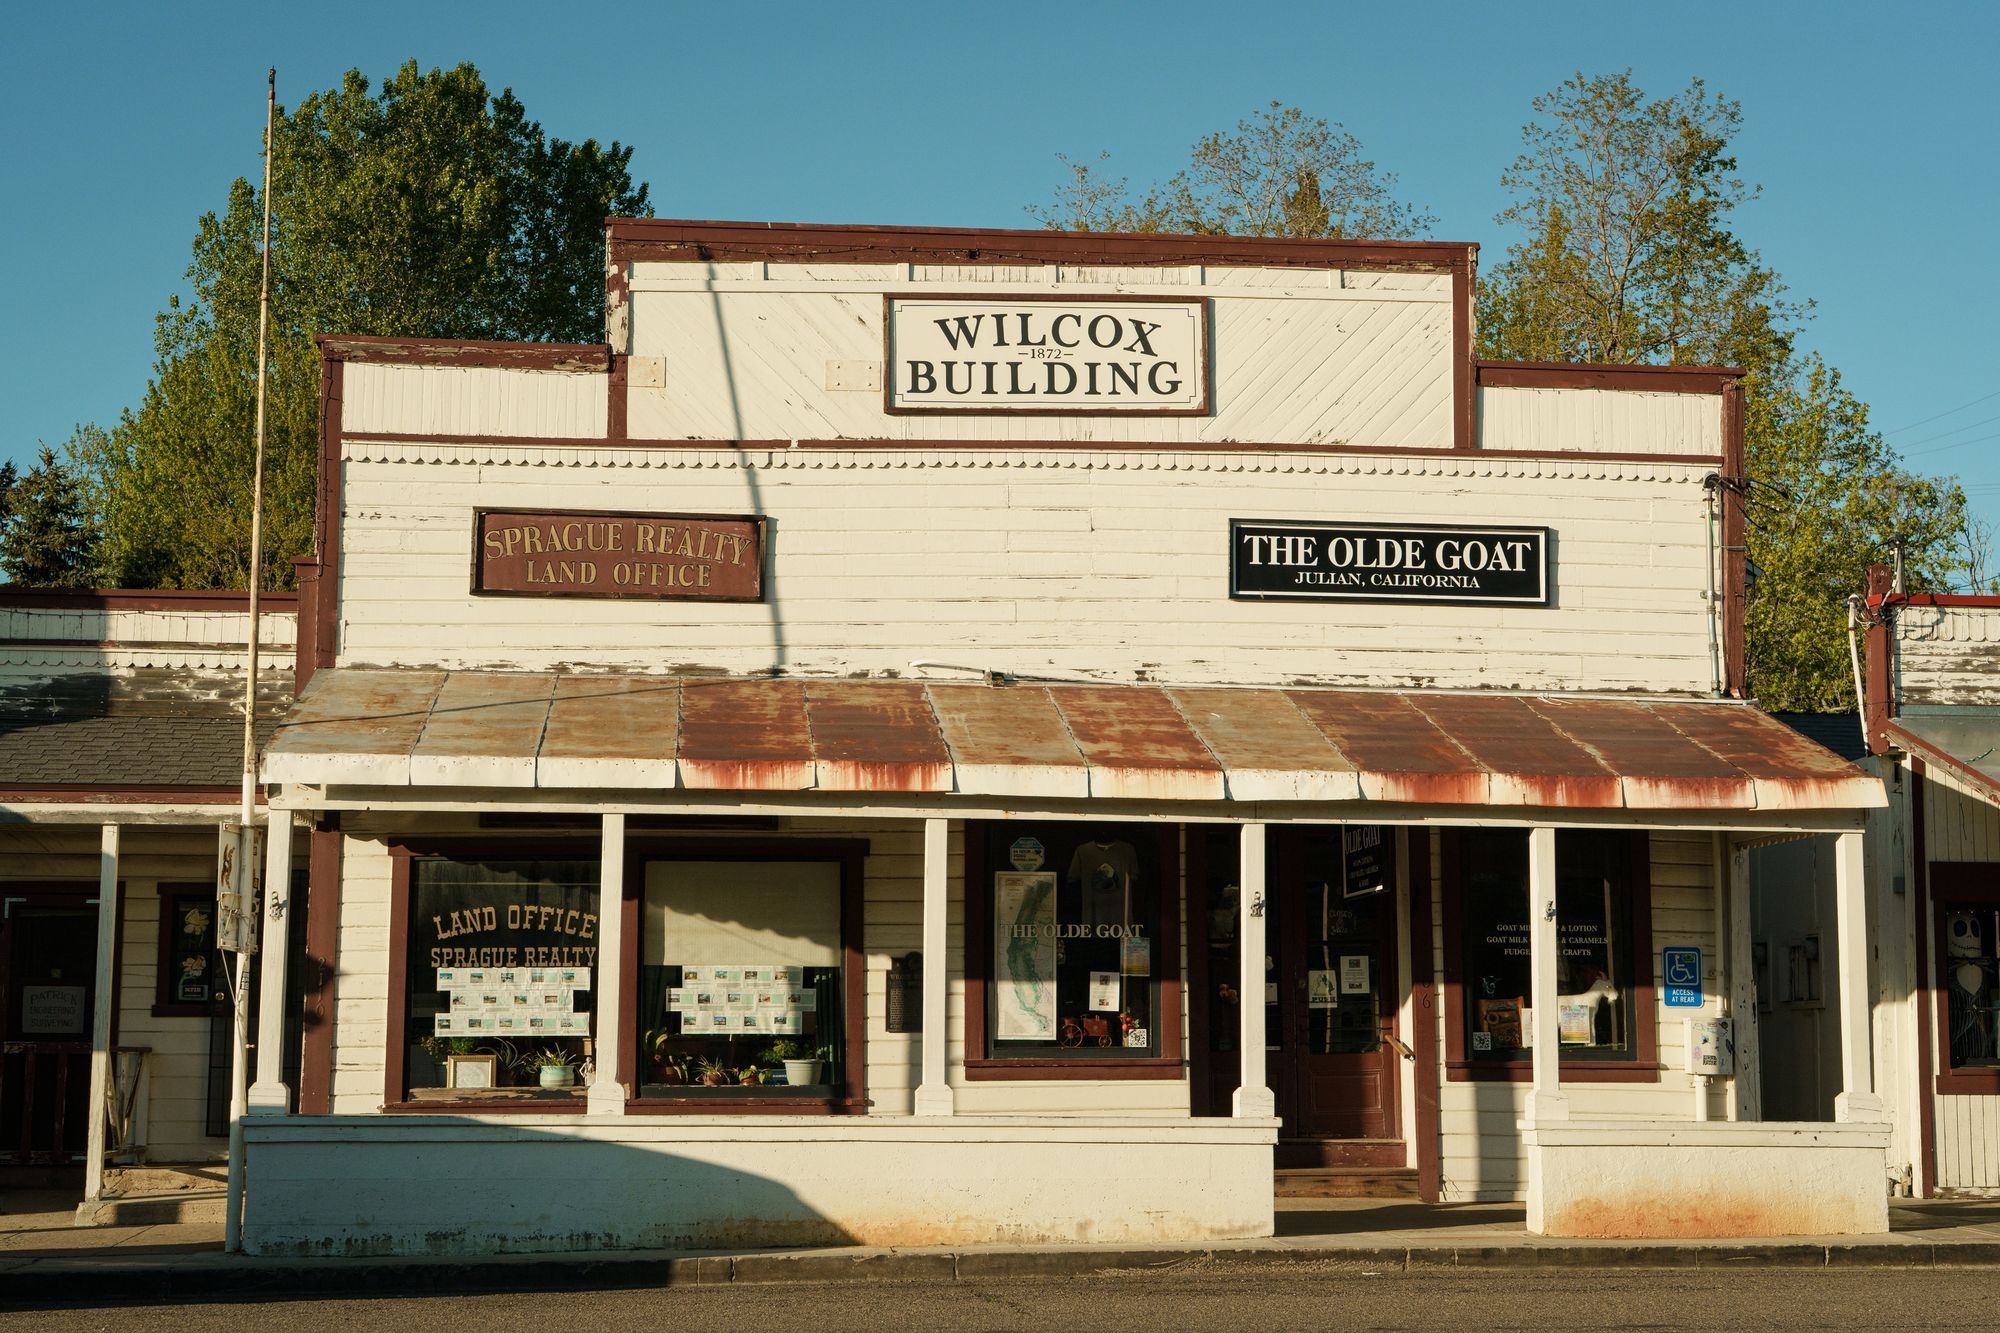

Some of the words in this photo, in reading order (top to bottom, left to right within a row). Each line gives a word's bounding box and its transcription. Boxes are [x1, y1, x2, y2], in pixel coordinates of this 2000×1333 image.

[933, 313, 1162, 357] WILCOX
[906, 361, 1183, 396] BUILDING
[484, 523, 624, 559] SPRAGUE
[636, 524, 752, 566] REALTY
[1243, 534, 1319, 566] THE
[1327, 537, 1426, 569] OLDE
[1435, 540, 1532, 572] GOAT
[526, 560, 598, 585] LAND
[613, 562, 711, 588] OFFICE
[1294, 571, 1366, 587] JULIAN,
[1371, 575, 1480, 589] CALIFORNIA
[432, 906, 497, 940] LAND
[508, 905, 597, 939] OFFICE
[1001, 924, 1037, 938] THE
[1043, 924, 1091, 938] OLDE
[1095, 924, 1144, 938] GOAT
[1497, 924, 1518, 932] GOAT
[431, 947, 517, 968] SPRAGUE
[524, 947, 597, 967] REALTY
[1672, 988, 1694, 996] ACCESS
